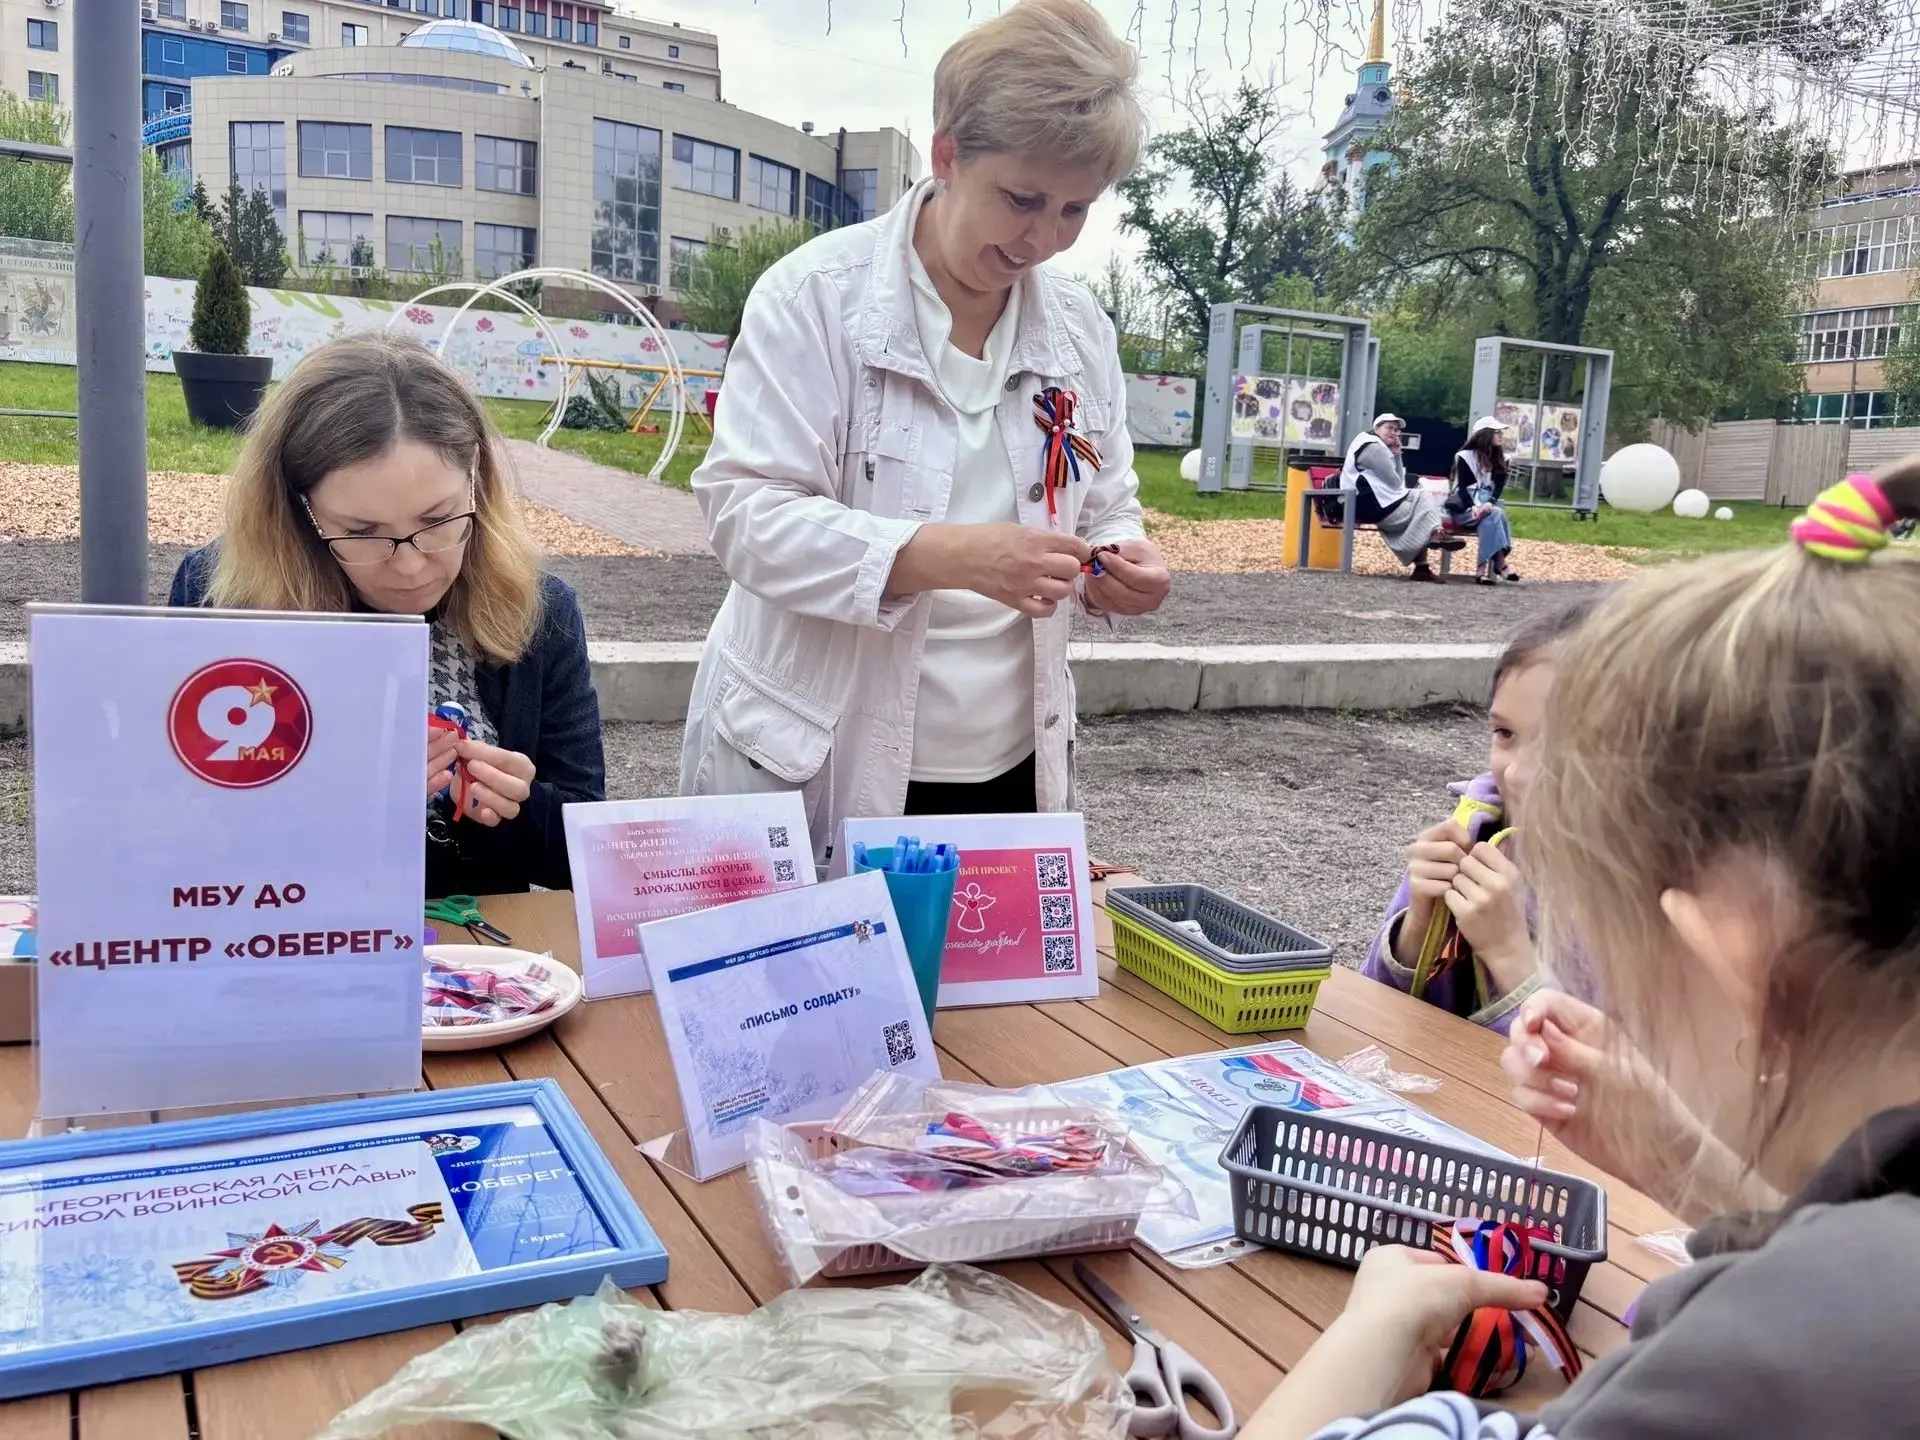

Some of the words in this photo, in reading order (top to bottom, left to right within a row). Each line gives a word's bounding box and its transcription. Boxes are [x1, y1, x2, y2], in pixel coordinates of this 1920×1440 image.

[197, 684, 277, 761] 9
[238, 745, 285, 762] МАЯ
[643, 867, 698, 881] СМЫСЛЫ,
[700, 862, 753, 875] КОТОРЫЕ
[980, 865, 1018, 875] ПРОЕКТ
[173, 884, 245, 908] МБУ
[254, 883, 306, 909] ДО
[633, 879, 722, 896] ЗАРОЖДАЮТСЯ
[732, 875, 766, 886] СЕМЬЕ
[49, 936, 212, 970] «ЦЕНТР
[224, 928, 414, 960] «ОБЕРЕГ»
[740, 1004, 798, 1032] «ПИСЬМО
[803, 986, 861, 1012] СОЛДАТУ»
[35, 1174, 266, 1214] «ГЕОРГИЕВСКАЯ
[273, 1161, 357, 1185] ЛЕНТА
[133, 1180, 302, 1218] ВОИНСКОЙ
[308, 1167, 417, 1193] СЛАВЫ»
[449, 1167, 576, 1194] «ОБЕРЕГ»
